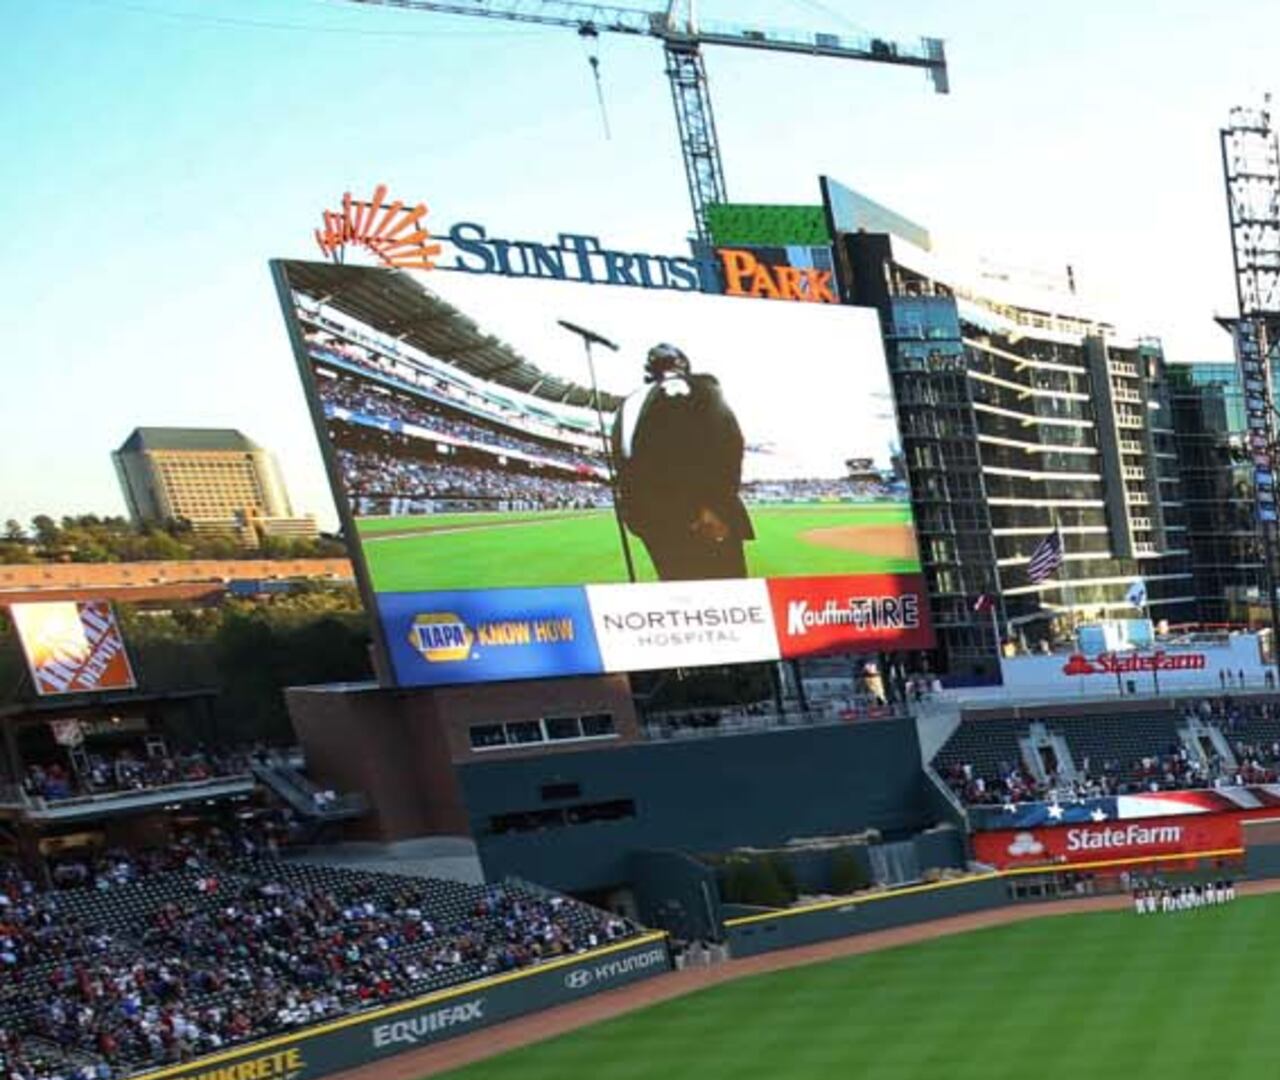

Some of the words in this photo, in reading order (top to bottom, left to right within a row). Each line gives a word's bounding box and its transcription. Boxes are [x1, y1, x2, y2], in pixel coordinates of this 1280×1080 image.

[603, 606, 766, 631] NORTHSIDE
[850, 595, 919, 631] TIRE
[418, 623, 467, 651] NAPA
[477, 621, 530, 646] KNOW
[637, 630, 741, 648] HOSPITAL
[1066, 824, 1182, 852] StateFarm
[595, 950, 666, 981] HYUNDAI
[371, 998, 486, 1048] EQUIFAX
